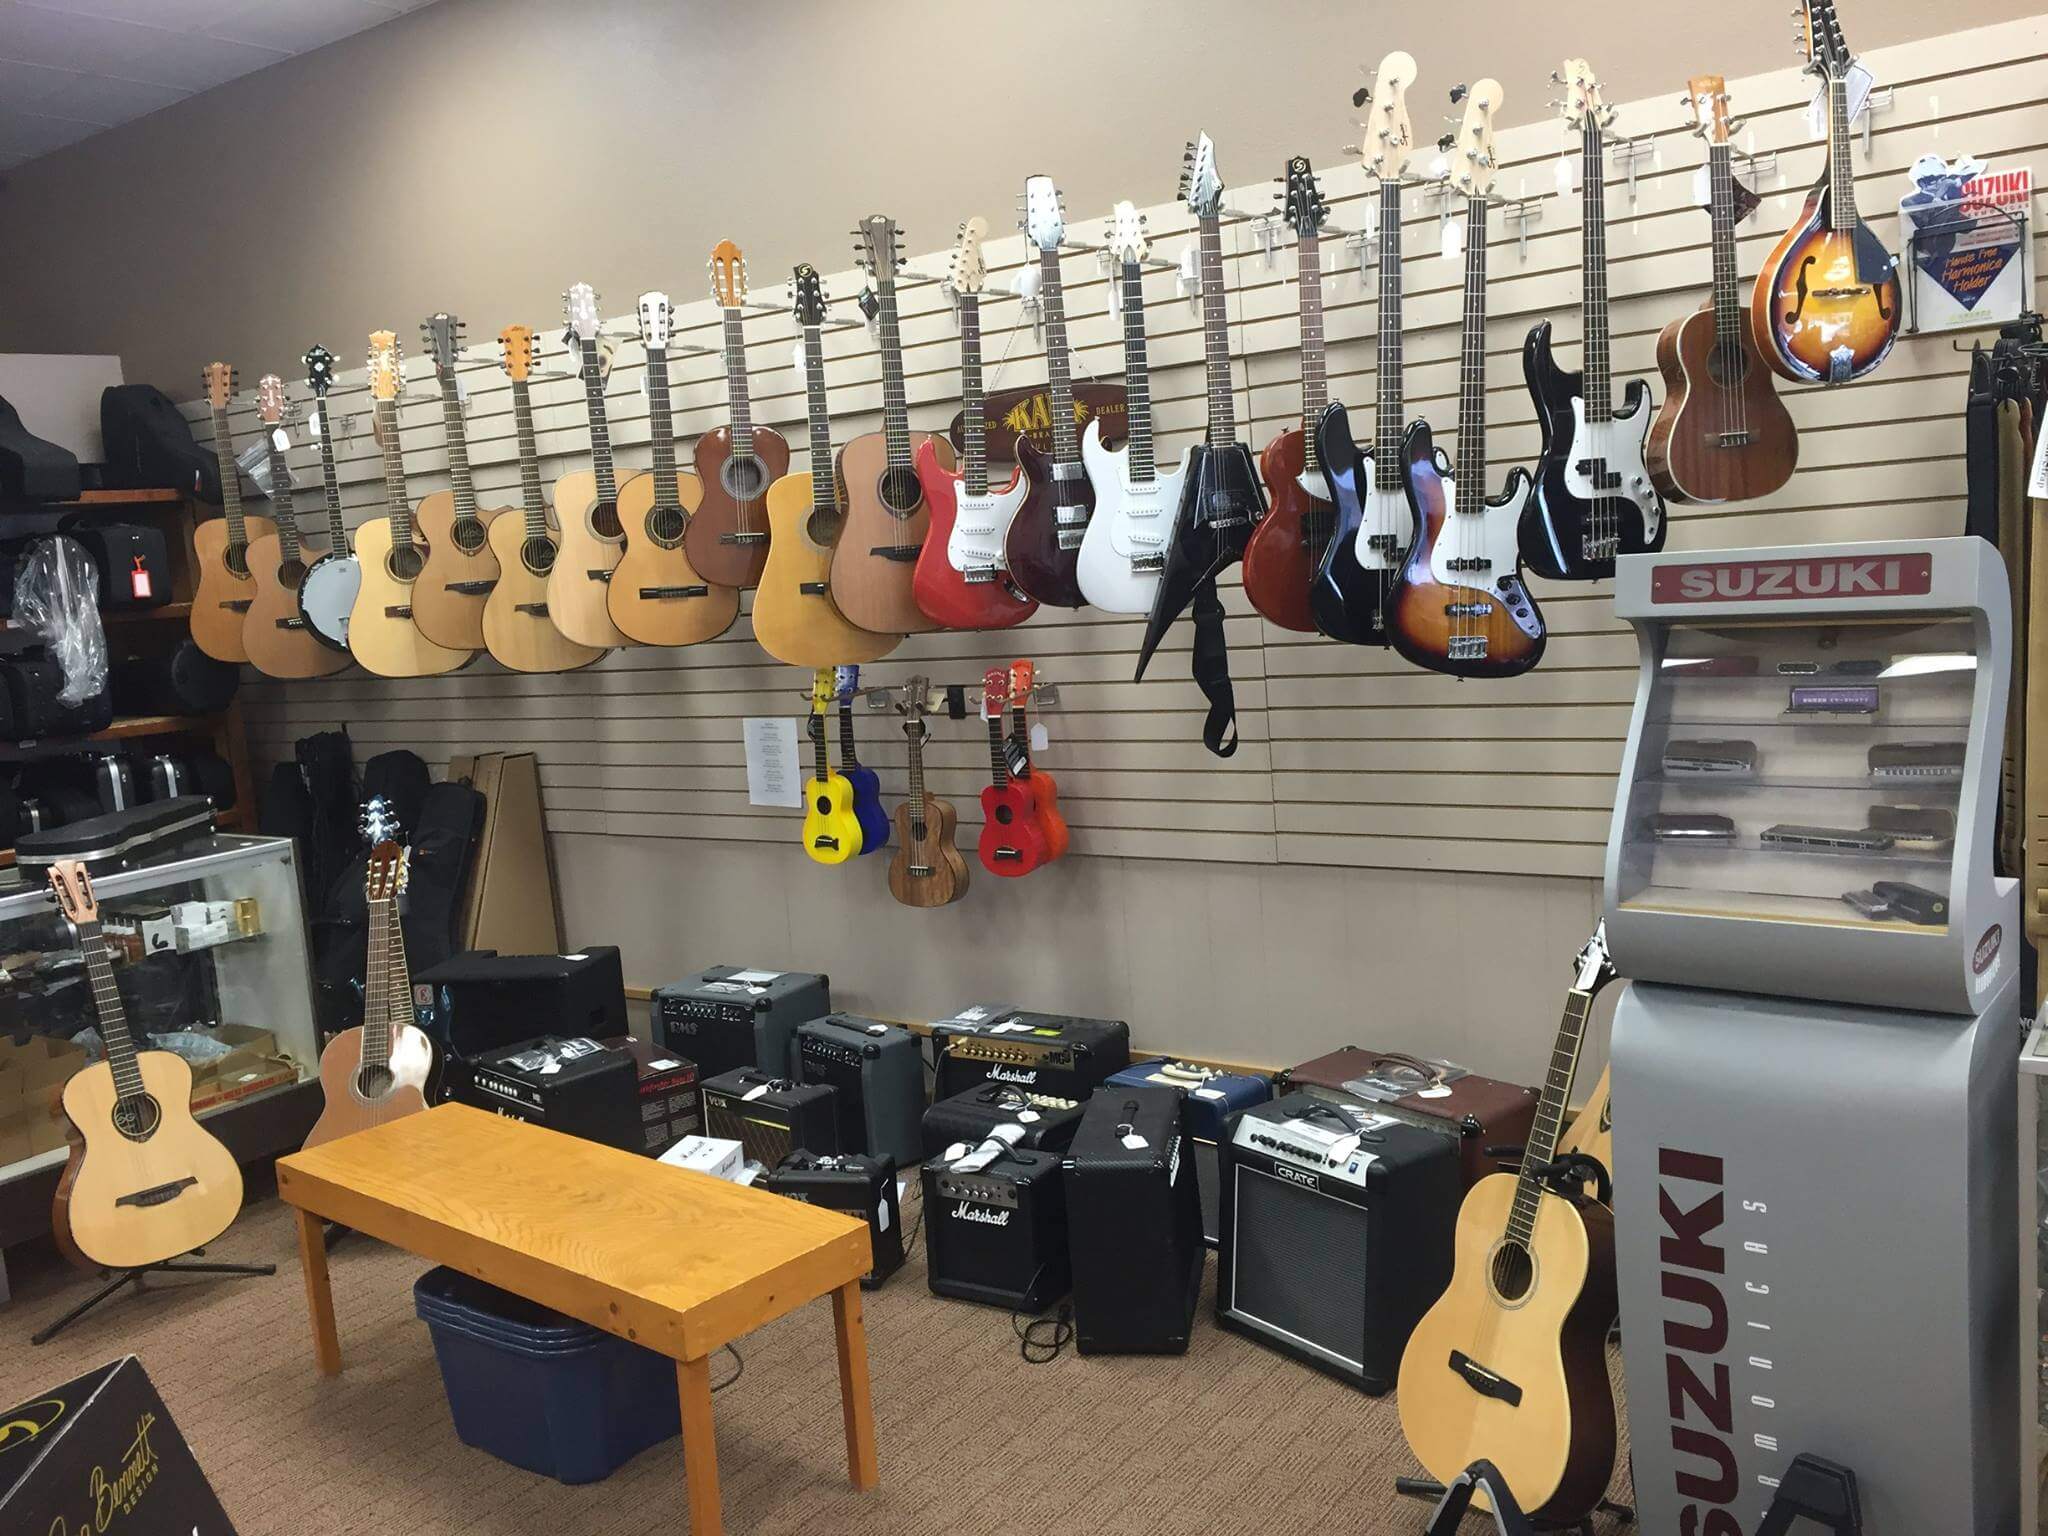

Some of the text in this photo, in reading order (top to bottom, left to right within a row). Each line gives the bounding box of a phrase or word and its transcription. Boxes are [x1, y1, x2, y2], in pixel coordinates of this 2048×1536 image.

[1942, 258, 2003, 281] Harmonica
[1953, 275, 1991, 293] Holder
[1095, 403, 1126, 416] DEALER
[1679, 560, 1901, 599] SUZUKI
[670, 1021, 698, 1036] RMS
[986, 1063, 1038, 1085] Marshall
[707, 1095, 728, 1109] VOX
[1278, 1167, 1317, 1188] CRATE
[951, 1201, 1010, 1227] Marshall
[89, 1413, 159, 1533] Bennett
[122, 1464, 160, 1515] DESIGN
